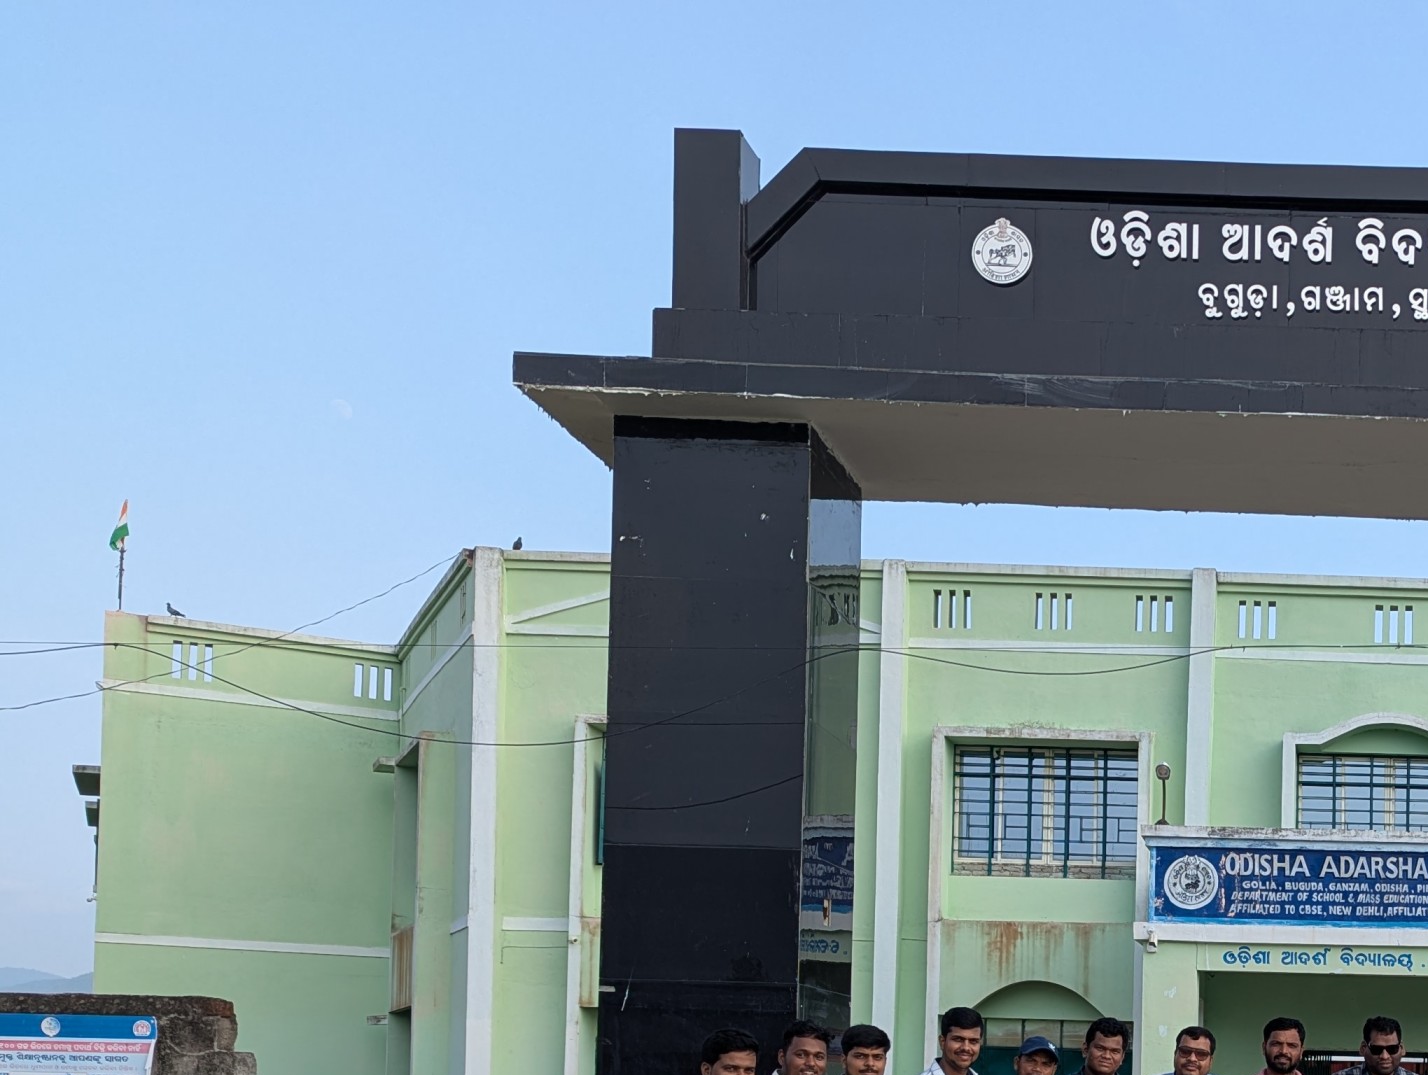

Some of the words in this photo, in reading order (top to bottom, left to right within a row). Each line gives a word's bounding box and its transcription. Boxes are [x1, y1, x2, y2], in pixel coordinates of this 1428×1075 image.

[1089, 209, 1200, 267] ଓଡ଼ିଶା
[1221, 217, 1333, 262] ଆଦର୍ଶ
[1224, 852, 1311, 878] ODISHA
[1230, 890, 1295, 902] DEPARTMENT
[1296, 892, 1310, 901] OF
[1311, 892, 1346, 903] SCHOOL
[1357, 893, 1381, 904] MASS
[1228, 903, 1281, 915] AFFILIATED
[1284, 904, 1296, 915] TO
[1298, 904, 1327, 917] CBSE,
[1328, 905, 1352, 916] NEW
[1222, 945, 1271, 968] ଓଡ଼ିଶା
[1280, 948, 1332, 966] ଆଦର୍ଶ
